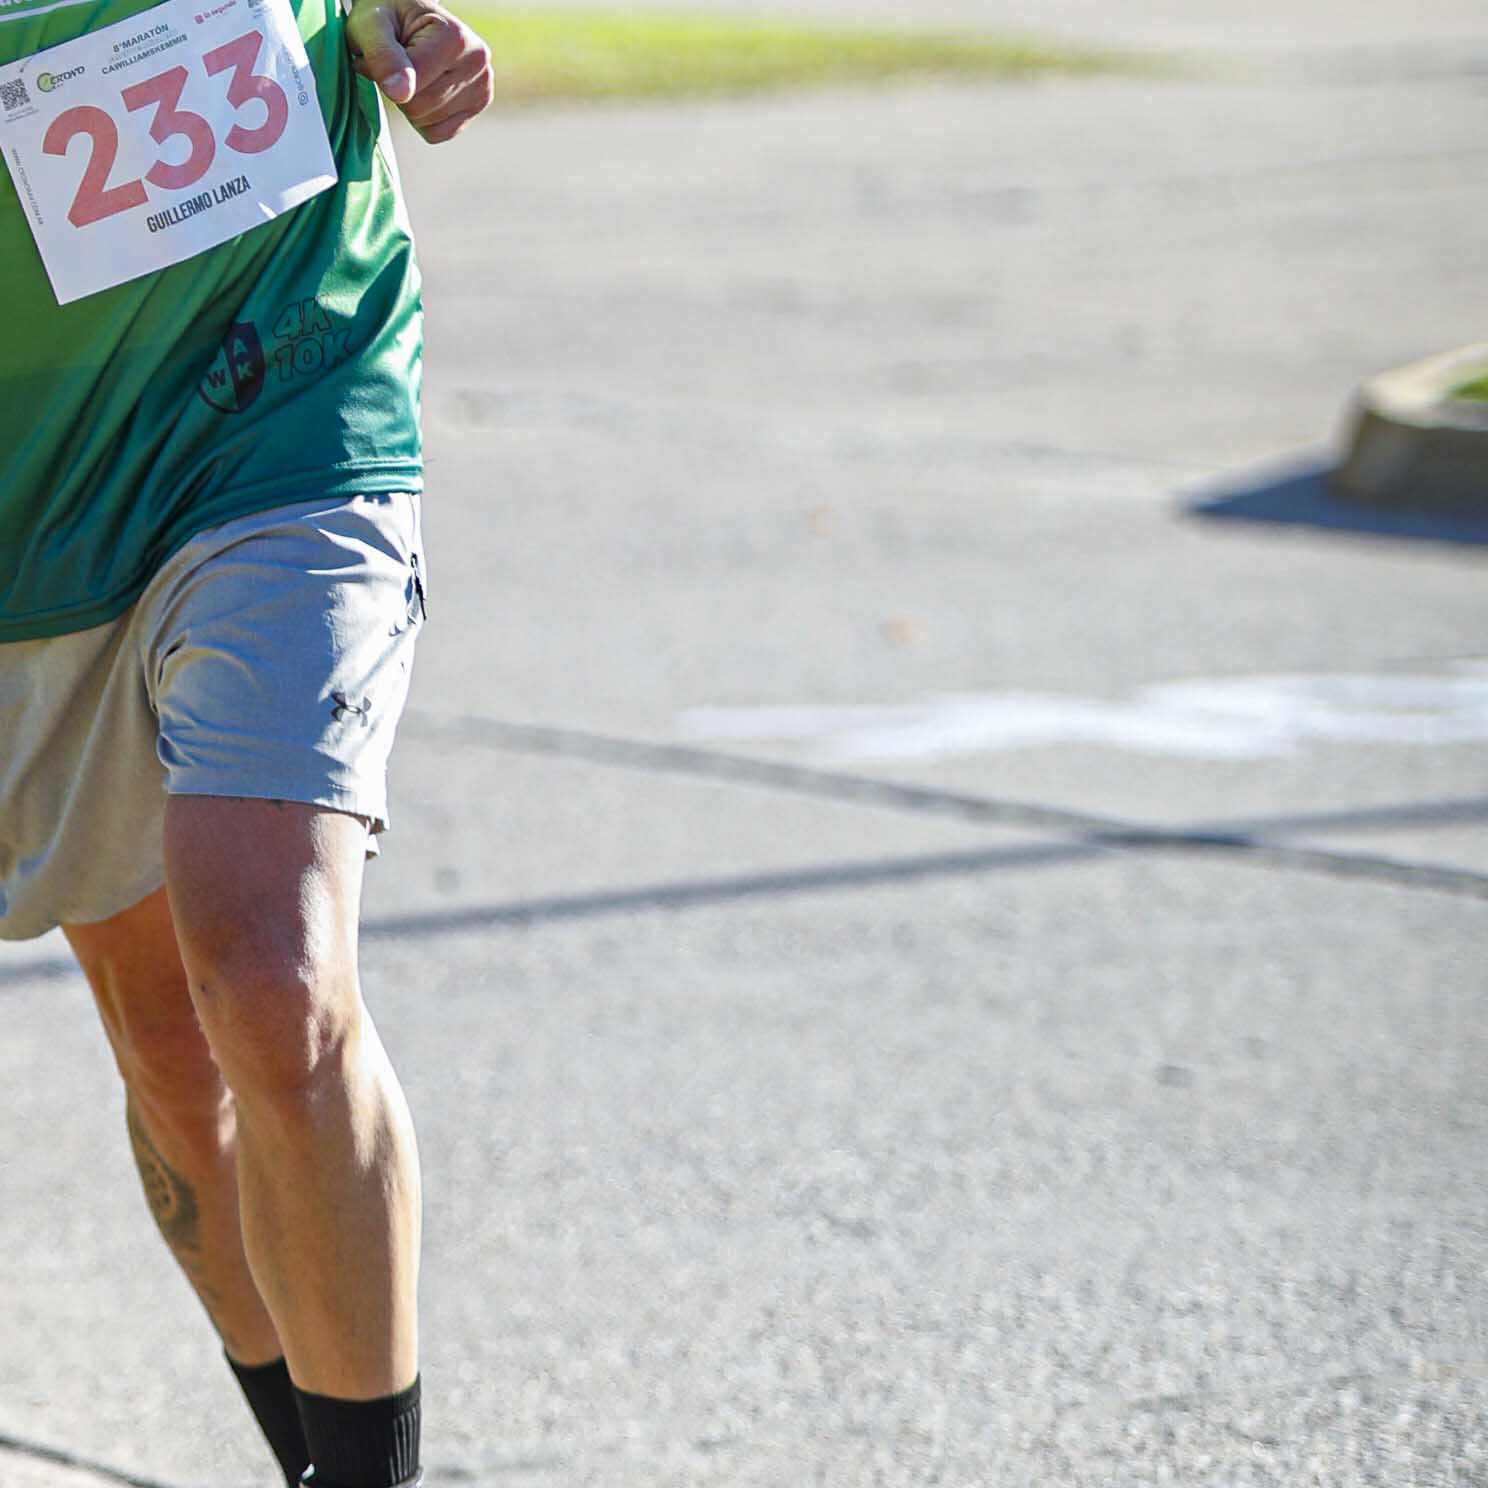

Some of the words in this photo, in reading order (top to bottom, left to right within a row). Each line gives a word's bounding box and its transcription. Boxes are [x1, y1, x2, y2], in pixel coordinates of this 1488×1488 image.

[42, 28, 290, 229] 233
[146, 191, 213, 233] GUILLERMO
[212, 174, 252, 204] LANZA
